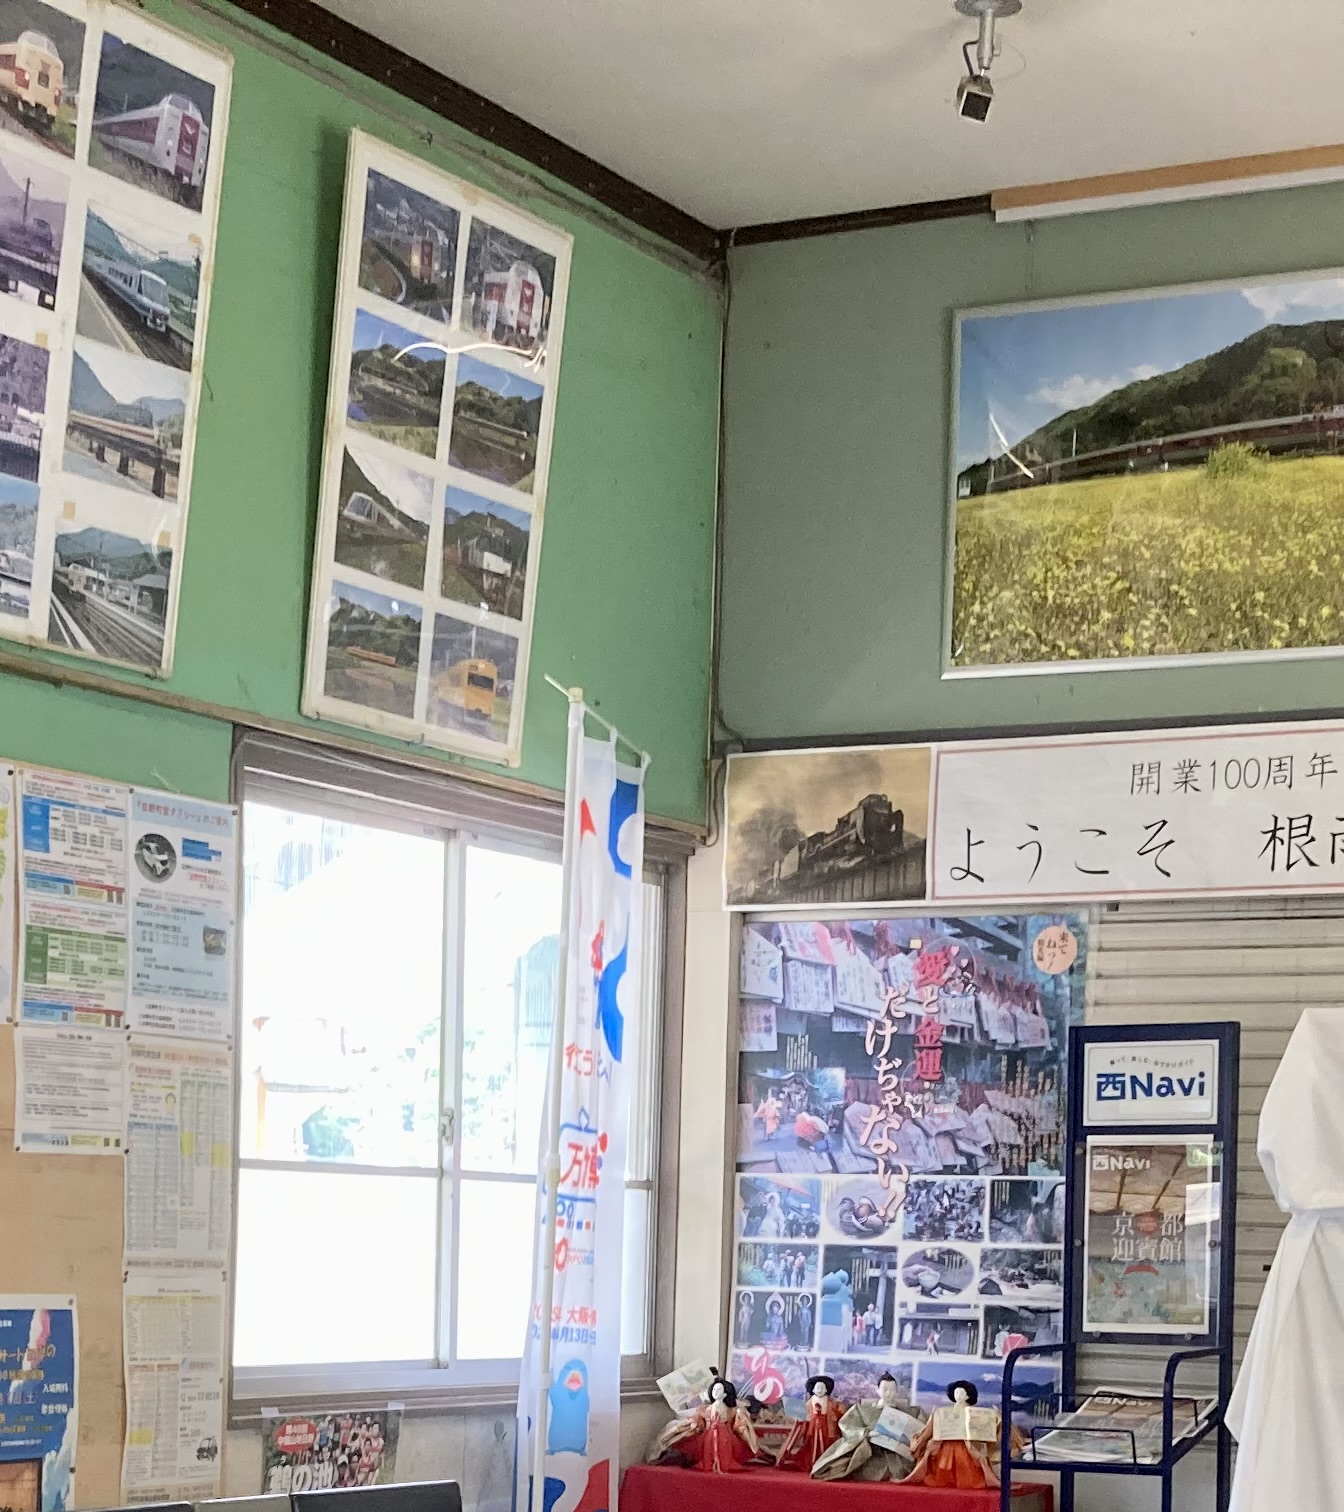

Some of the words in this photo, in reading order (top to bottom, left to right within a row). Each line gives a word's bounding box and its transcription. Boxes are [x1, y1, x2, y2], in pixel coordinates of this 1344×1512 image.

[1128, 752, 1340, 796] 開業100周年
[949, 819, 1178, 882] ようこそ
[1096, 1071, 1205, 1101] 西Navi
[1092, 1154, 1151, 1171] 西Navi
